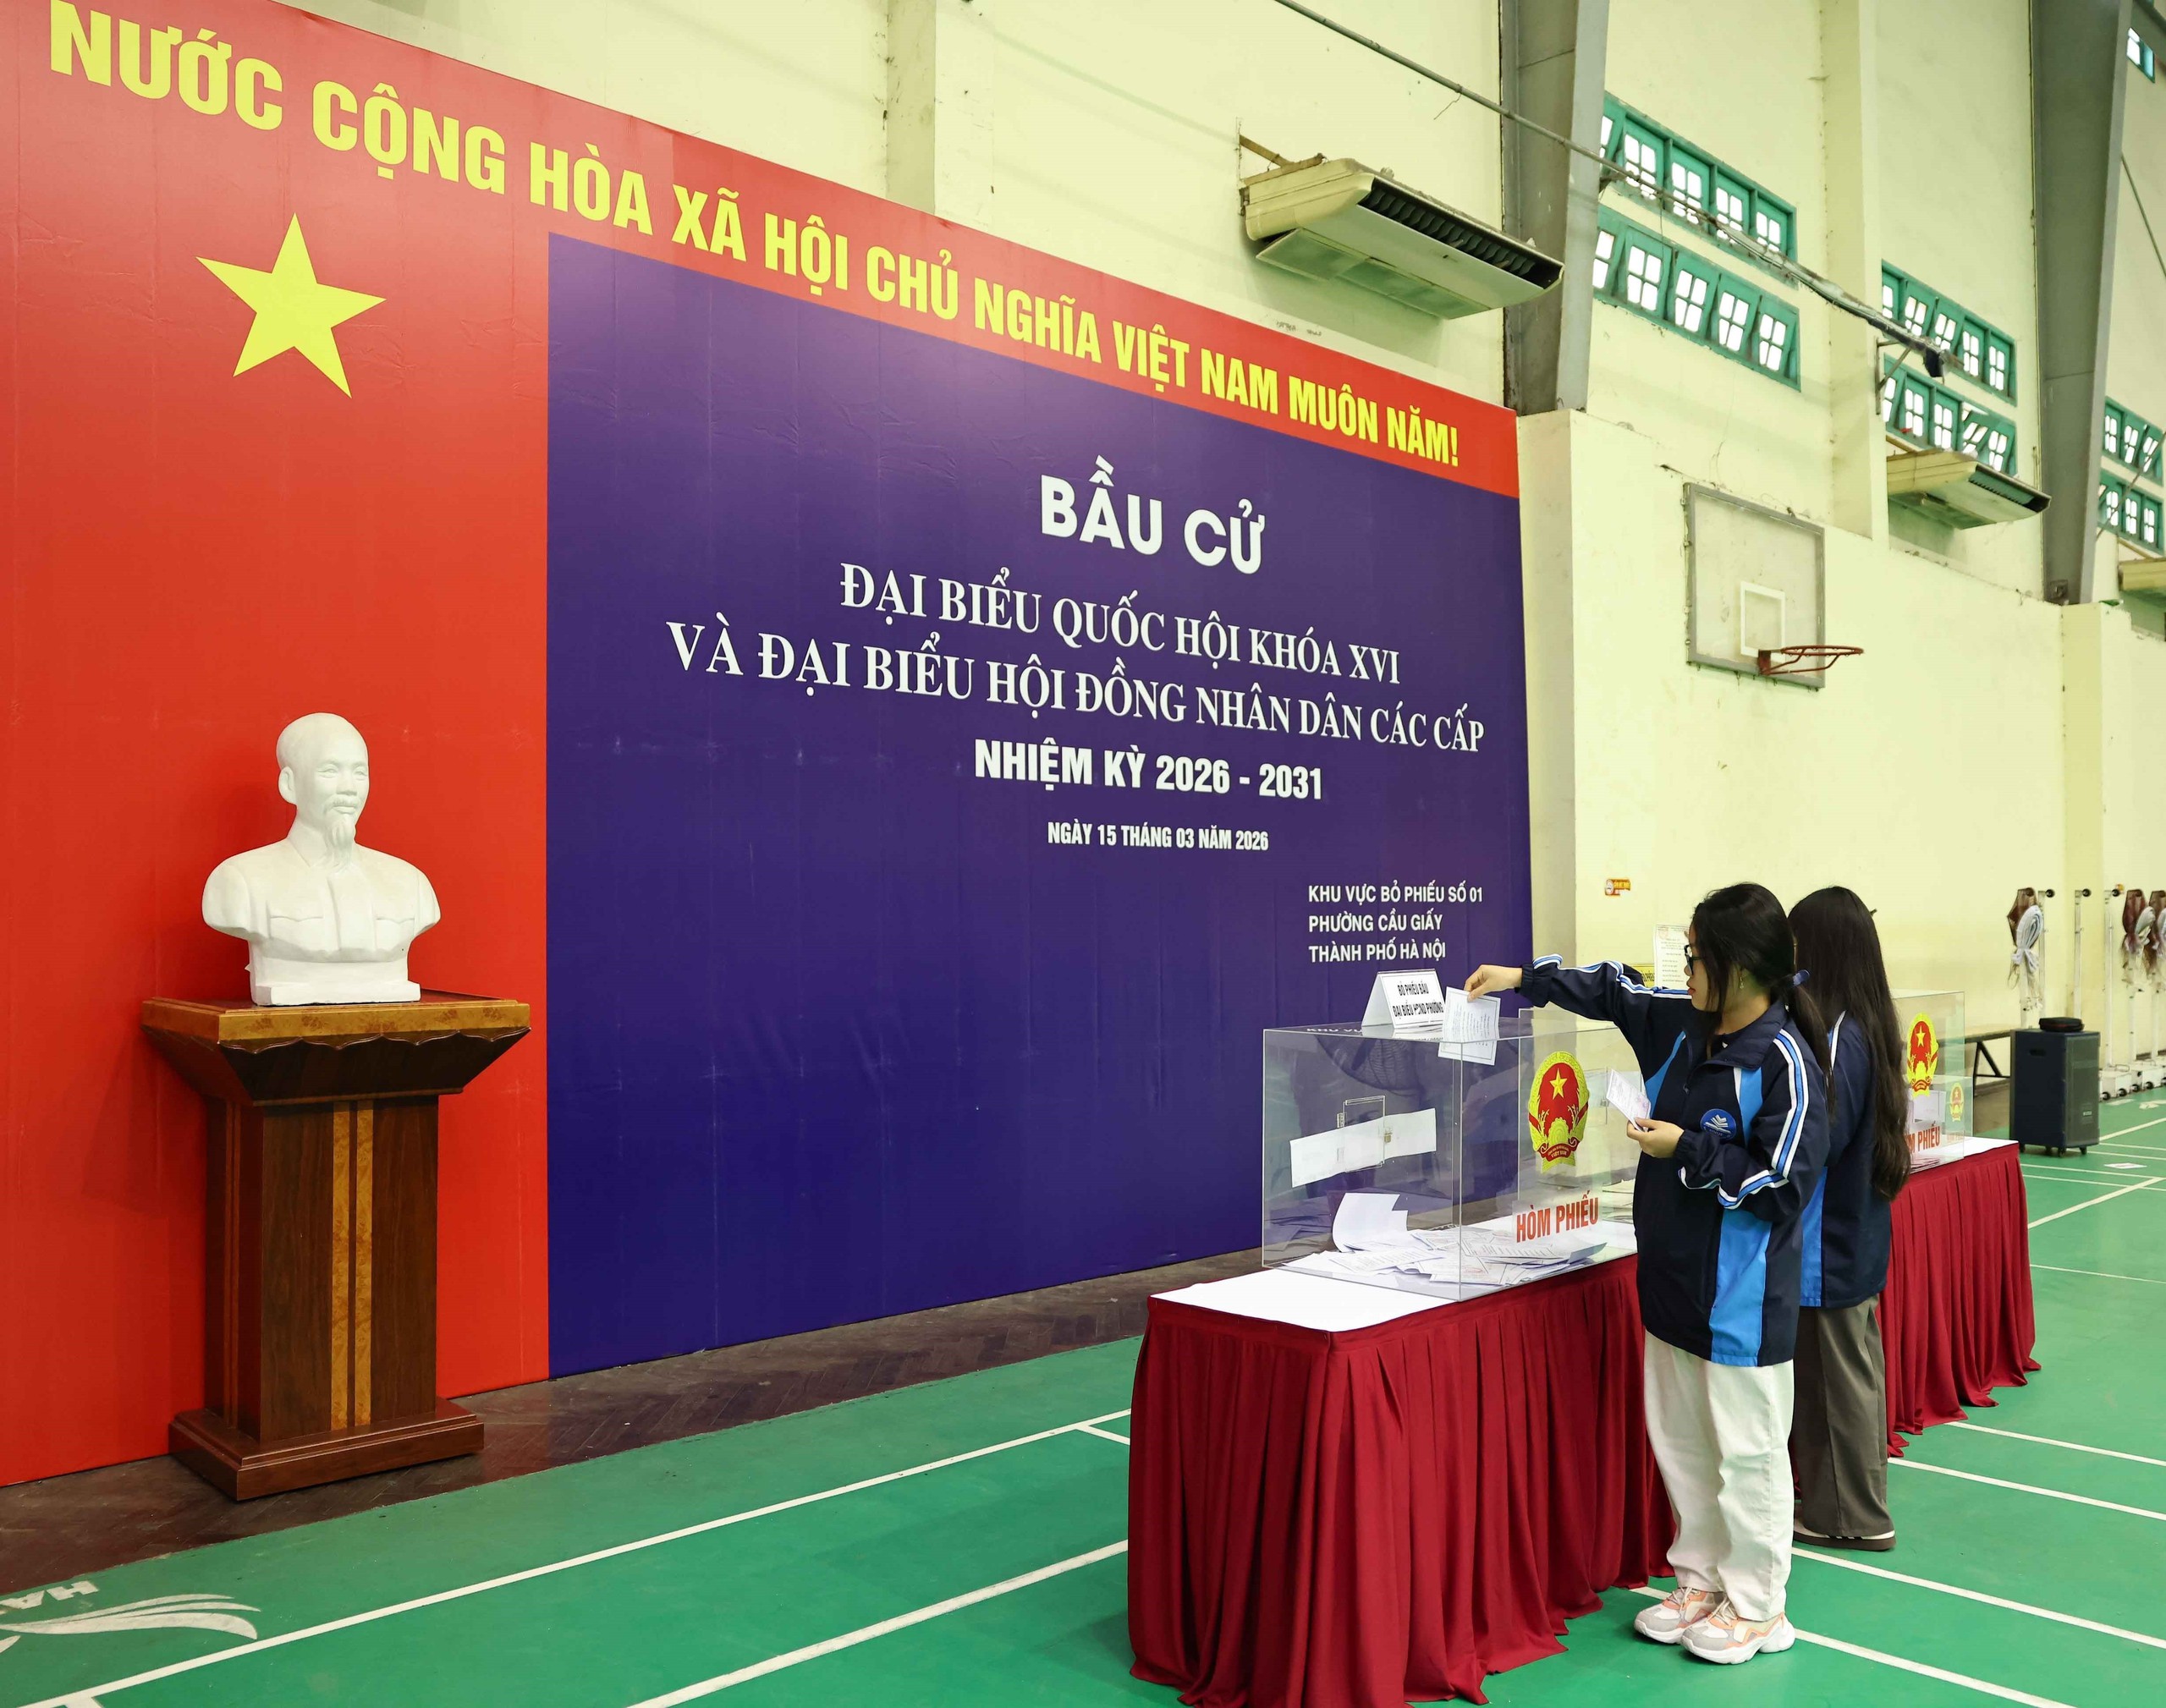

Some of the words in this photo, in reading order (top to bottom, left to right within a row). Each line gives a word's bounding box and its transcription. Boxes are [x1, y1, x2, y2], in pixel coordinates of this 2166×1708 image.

[51, 0, 283, 130] NƯỚC
[313, 81, 505, 194] CỘNG
[530, 142, 652, 235] HÒA
[672, 184, 746, 261] XÃ
[765, 213, 848, 295] HỘI
[866, 246, 959, 320] CHỦ
[975, 277, 1102, 363] NGHĨA
[1113, 321, 1190, 393] VIỆT
[1201, 349, 1278, 414] NAM
[1289, 378, 1377, 442] MUÔN
[1387, 406, 1458, 466] NĂM!
[1042, 455, 1162, 555] BẦU
[1185, 499, 1265, 574] CỬ
[840, 563, 926, 624] ĐẠI
[938, 567, 1042, 633] BIỂU
[1053, 590, 1164, 651] QUỐC
[1174, 611, 1240, 669] HỘI
[1249, 627, 1341, 675] KHÓA
[1349, 645, 1399, 684] XVI
[666, 612, 743, 675] VÀ
[758, 633, 850, 695] ĐẠI
[864, 632, 975, 699] BIỂU
[987, 654, 1065, 718] HỘI
[1075, 656, 1186, 722] ĐỒNG
[1196, 683, 1290, 733] NHÂN
[1299, 692, 1362, 740] DÂN
[1371, 701, 1427, 746] CÁC
[1434, 703, 1483, 751] CẤP
[976, 738, 1091, 790] NHIỆM
[1105, 744, 1146, 788] KỲ
[1156, 755, 1229, 794] 2026
[1259, 764, 1321, 799] 2031
[1048, 819, 1092, 844] NGÀY
[1097, 825, 1116, 845] 15
[1121, 822, 1172, 847] THÁNG
[1176, 828, 1194, 848] 03
[1199, 825, 1231, 849] NĂM
[1236, 831, 1268, 850] 2026
[1309, 886, 1340, 902] KHU
[1345, 884, 1376, 905] VỰC
[1381, 880, 1400, 902] BỎ
[1405, 880, 1444, 902] PHIẾU
[1449, 881, 1466, 902] SỐ
[1470, 887, 1482, 902] 01
[1309, 911, 1373, 932] PHƯỜNG
[1378, 908, 1406, 931] CẦU
[1410, 908, 1443, 931] GIẤY
[1309, 941, 1361, 962] THÀNH
[1366, 936, 1396, 960] PHỐ
[1400, 939, 1419, 958] HÀ
[1423, 938, 1445, 961] NỘI
[1918, 1121, 1940, 1151] PHIẾU
[1517, 1205, 1550, 1243] HÒM
[1556, 1190, 1598, 1233] PHIẾU
